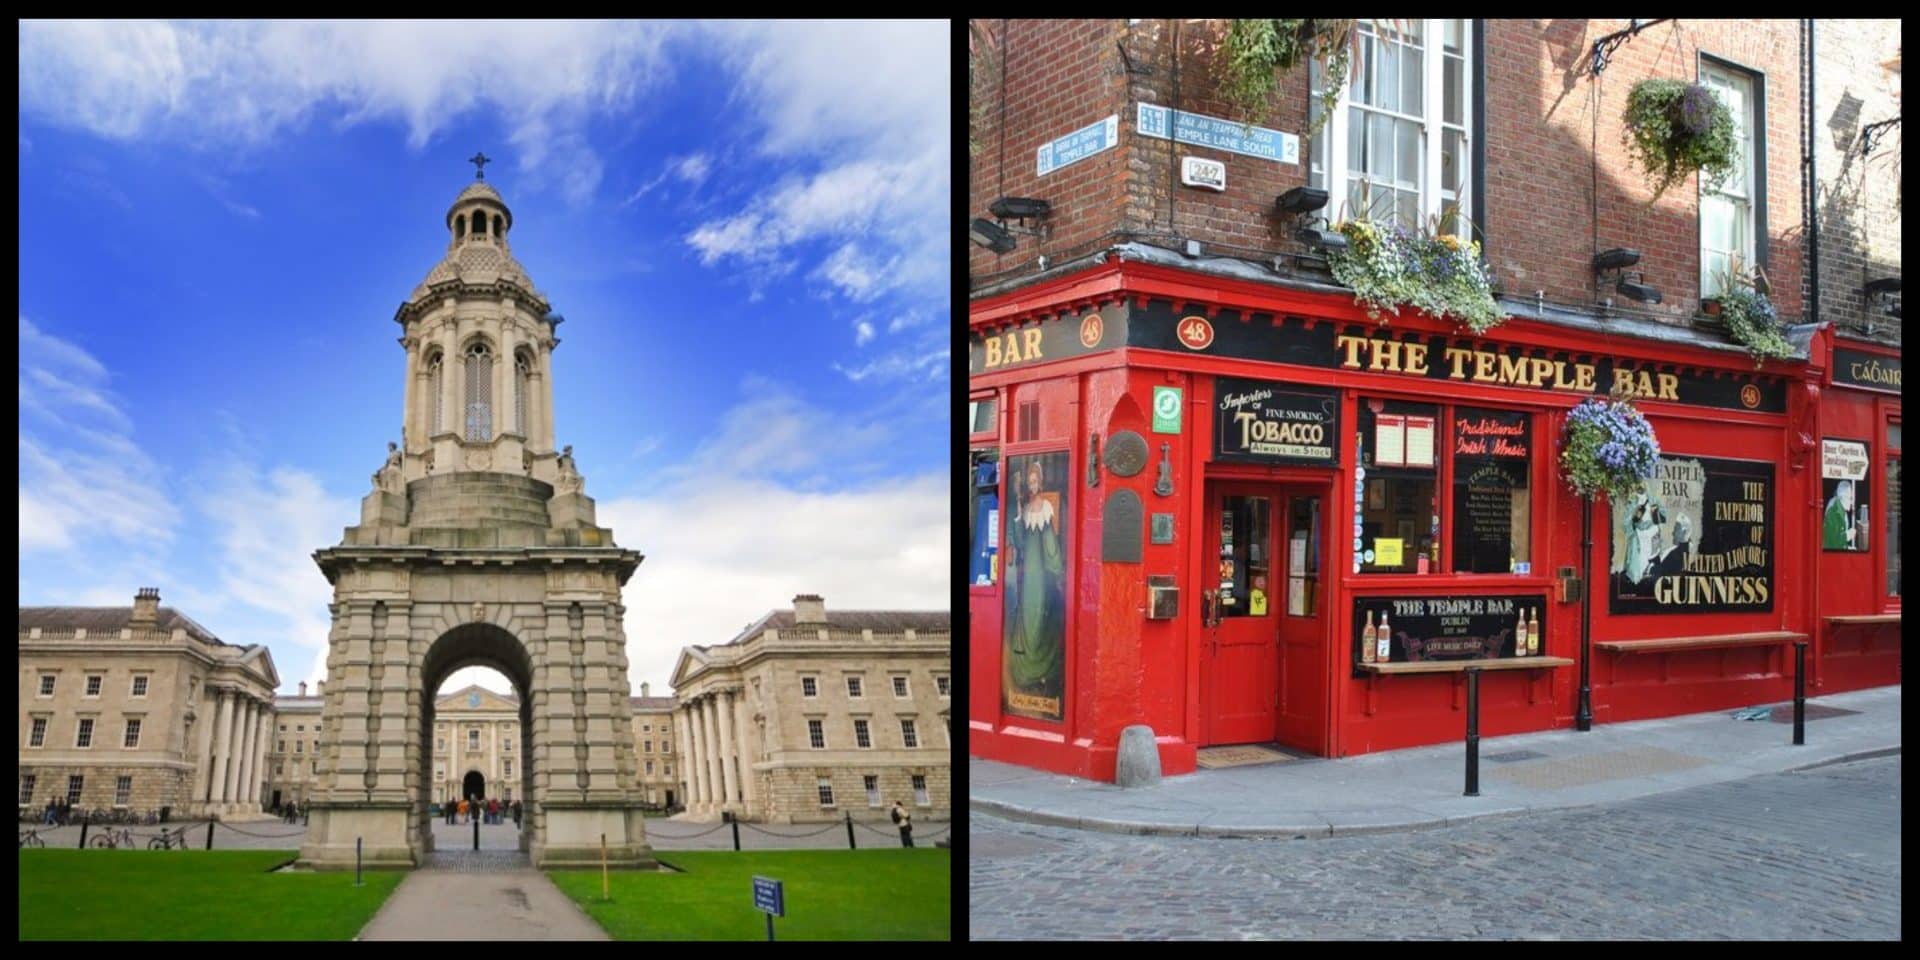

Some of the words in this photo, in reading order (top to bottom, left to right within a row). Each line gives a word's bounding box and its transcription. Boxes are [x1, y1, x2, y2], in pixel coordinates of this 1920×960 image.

[1108, 123, 1115, 139] 2
[1213, 136, 1240, 150] LANE
[1243, 141, 1277, 157] SOUTH
[1286, 142, 1296, 157] 2
[1083, 319, 1100, 342] 48
[1183, 320, 1206, 342] 48
[985, 327, 1043, 367] BAR
[1337, 335, 1429, 375] THE
[1445, 346, 1597, 393] TEMPLE
[1611, 366, 1681, 401] BAR
[1220, 388, 1273, 413] Importers
[1743, 388, 1757, 405] 48
[1265, 408, 1285, 420] FINE
[1286, 410, 1324, 421] SMOKING
[1233, 411, 1324, 449] TOBACCO
[1456, 418, 1524, 436] Traditional
[1252, 444, 1288, 455] Always
[1290, 448, 1300, 456] in
[1303, 446, 1330, 457] Stock
[1456, 437, 1486, 454] Irish
[1491, 438, 1526, 457] Music
[1654, 464, 1701, 482] EMPLE
[1662, 481, 1689, 498] BAR
[1742, 481, 1765, 501] THE
[1715, 502, 1764, 524] EMPEROR
[1751, 526, 1763, 544] OF
[1682, 552, 1725, 574] MALTED
[1727, 545, 1767, 571] LIQUORS
[1654, 575, 1768, 605] GUINNESS
[1393, 601, 1424, 616] THE
[1427, 600, 1484, 616] TEMPLE
[1487, 600, 1514, 616] BAR
[1441, 617, 1470, 626] DUBLIN
